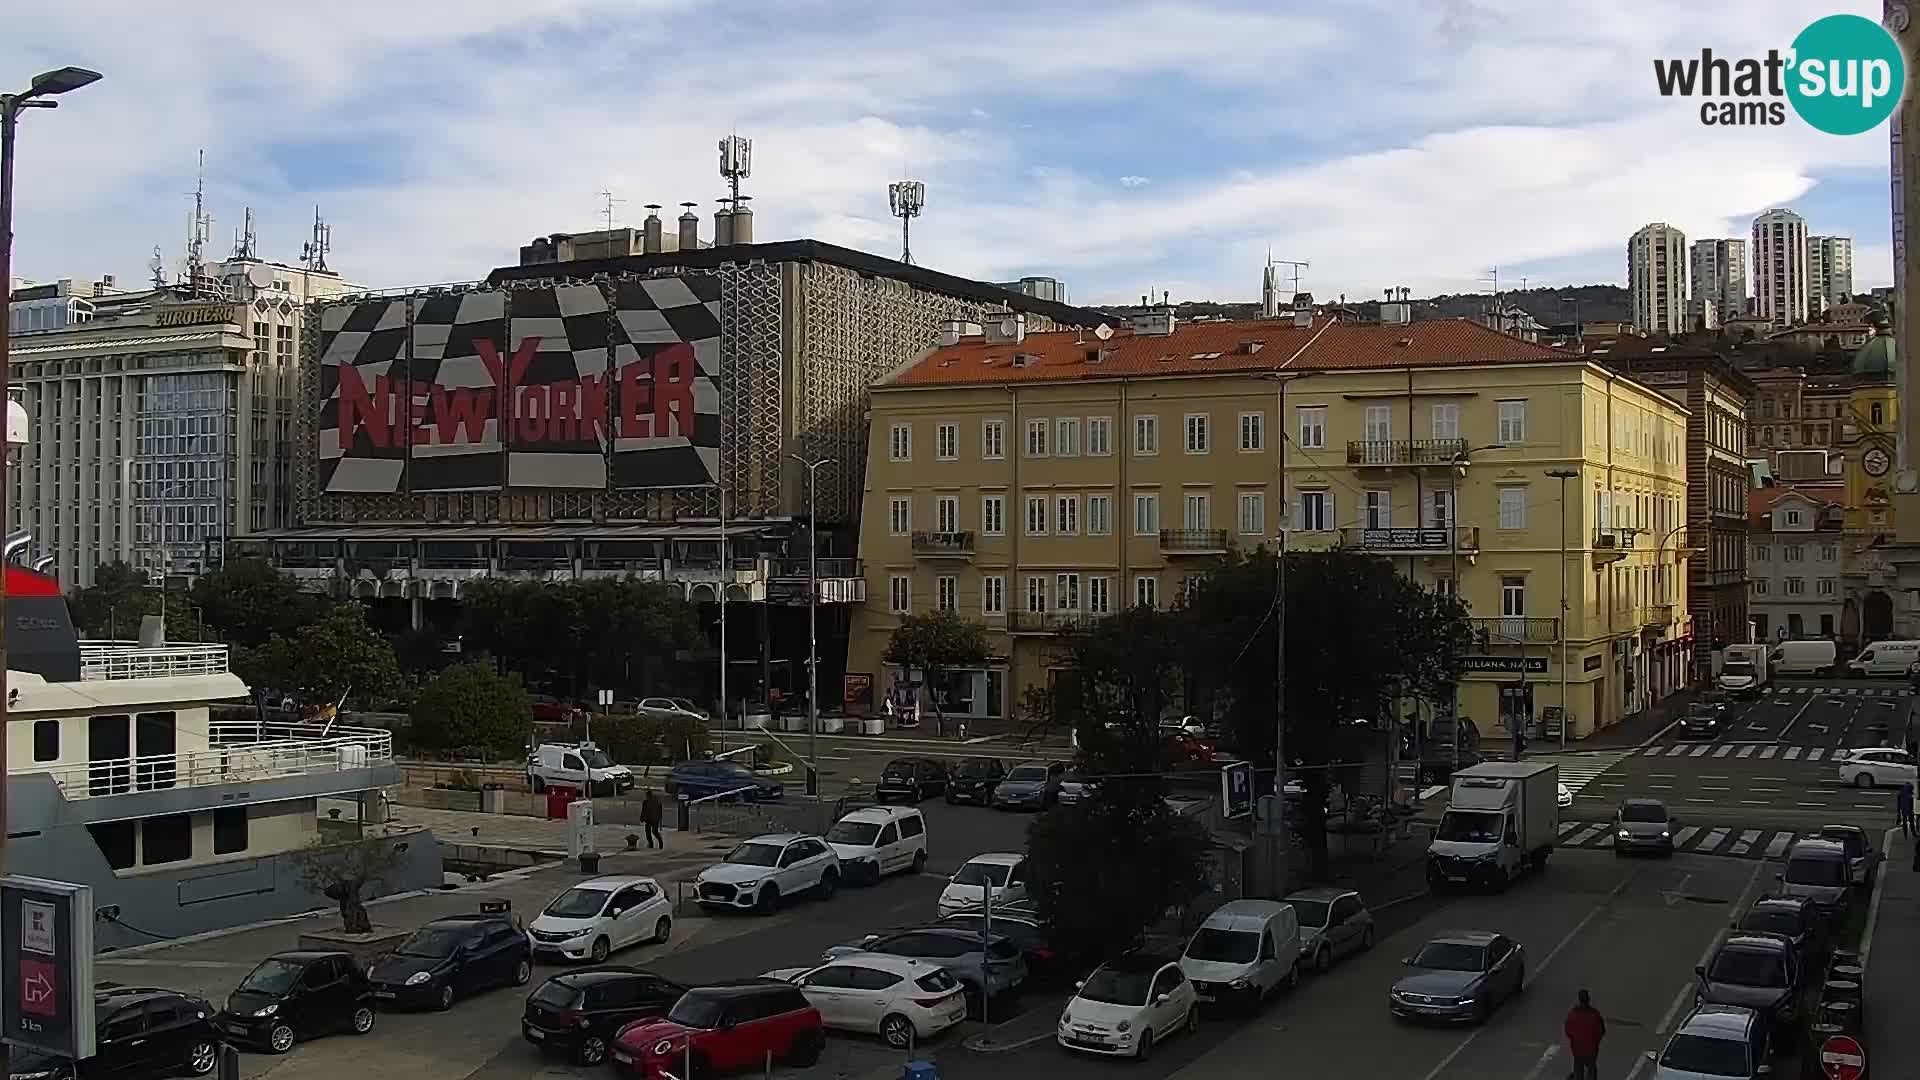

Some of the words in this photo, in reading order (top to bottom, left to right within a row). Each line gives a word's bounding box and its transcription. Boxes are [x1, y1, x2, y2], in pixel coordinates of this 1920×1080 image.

[1463, 659, 1507, 669] JULIANA
[1510, 659, 1543, 669] NAILS
[21, 1018, 28, 1029] 5
